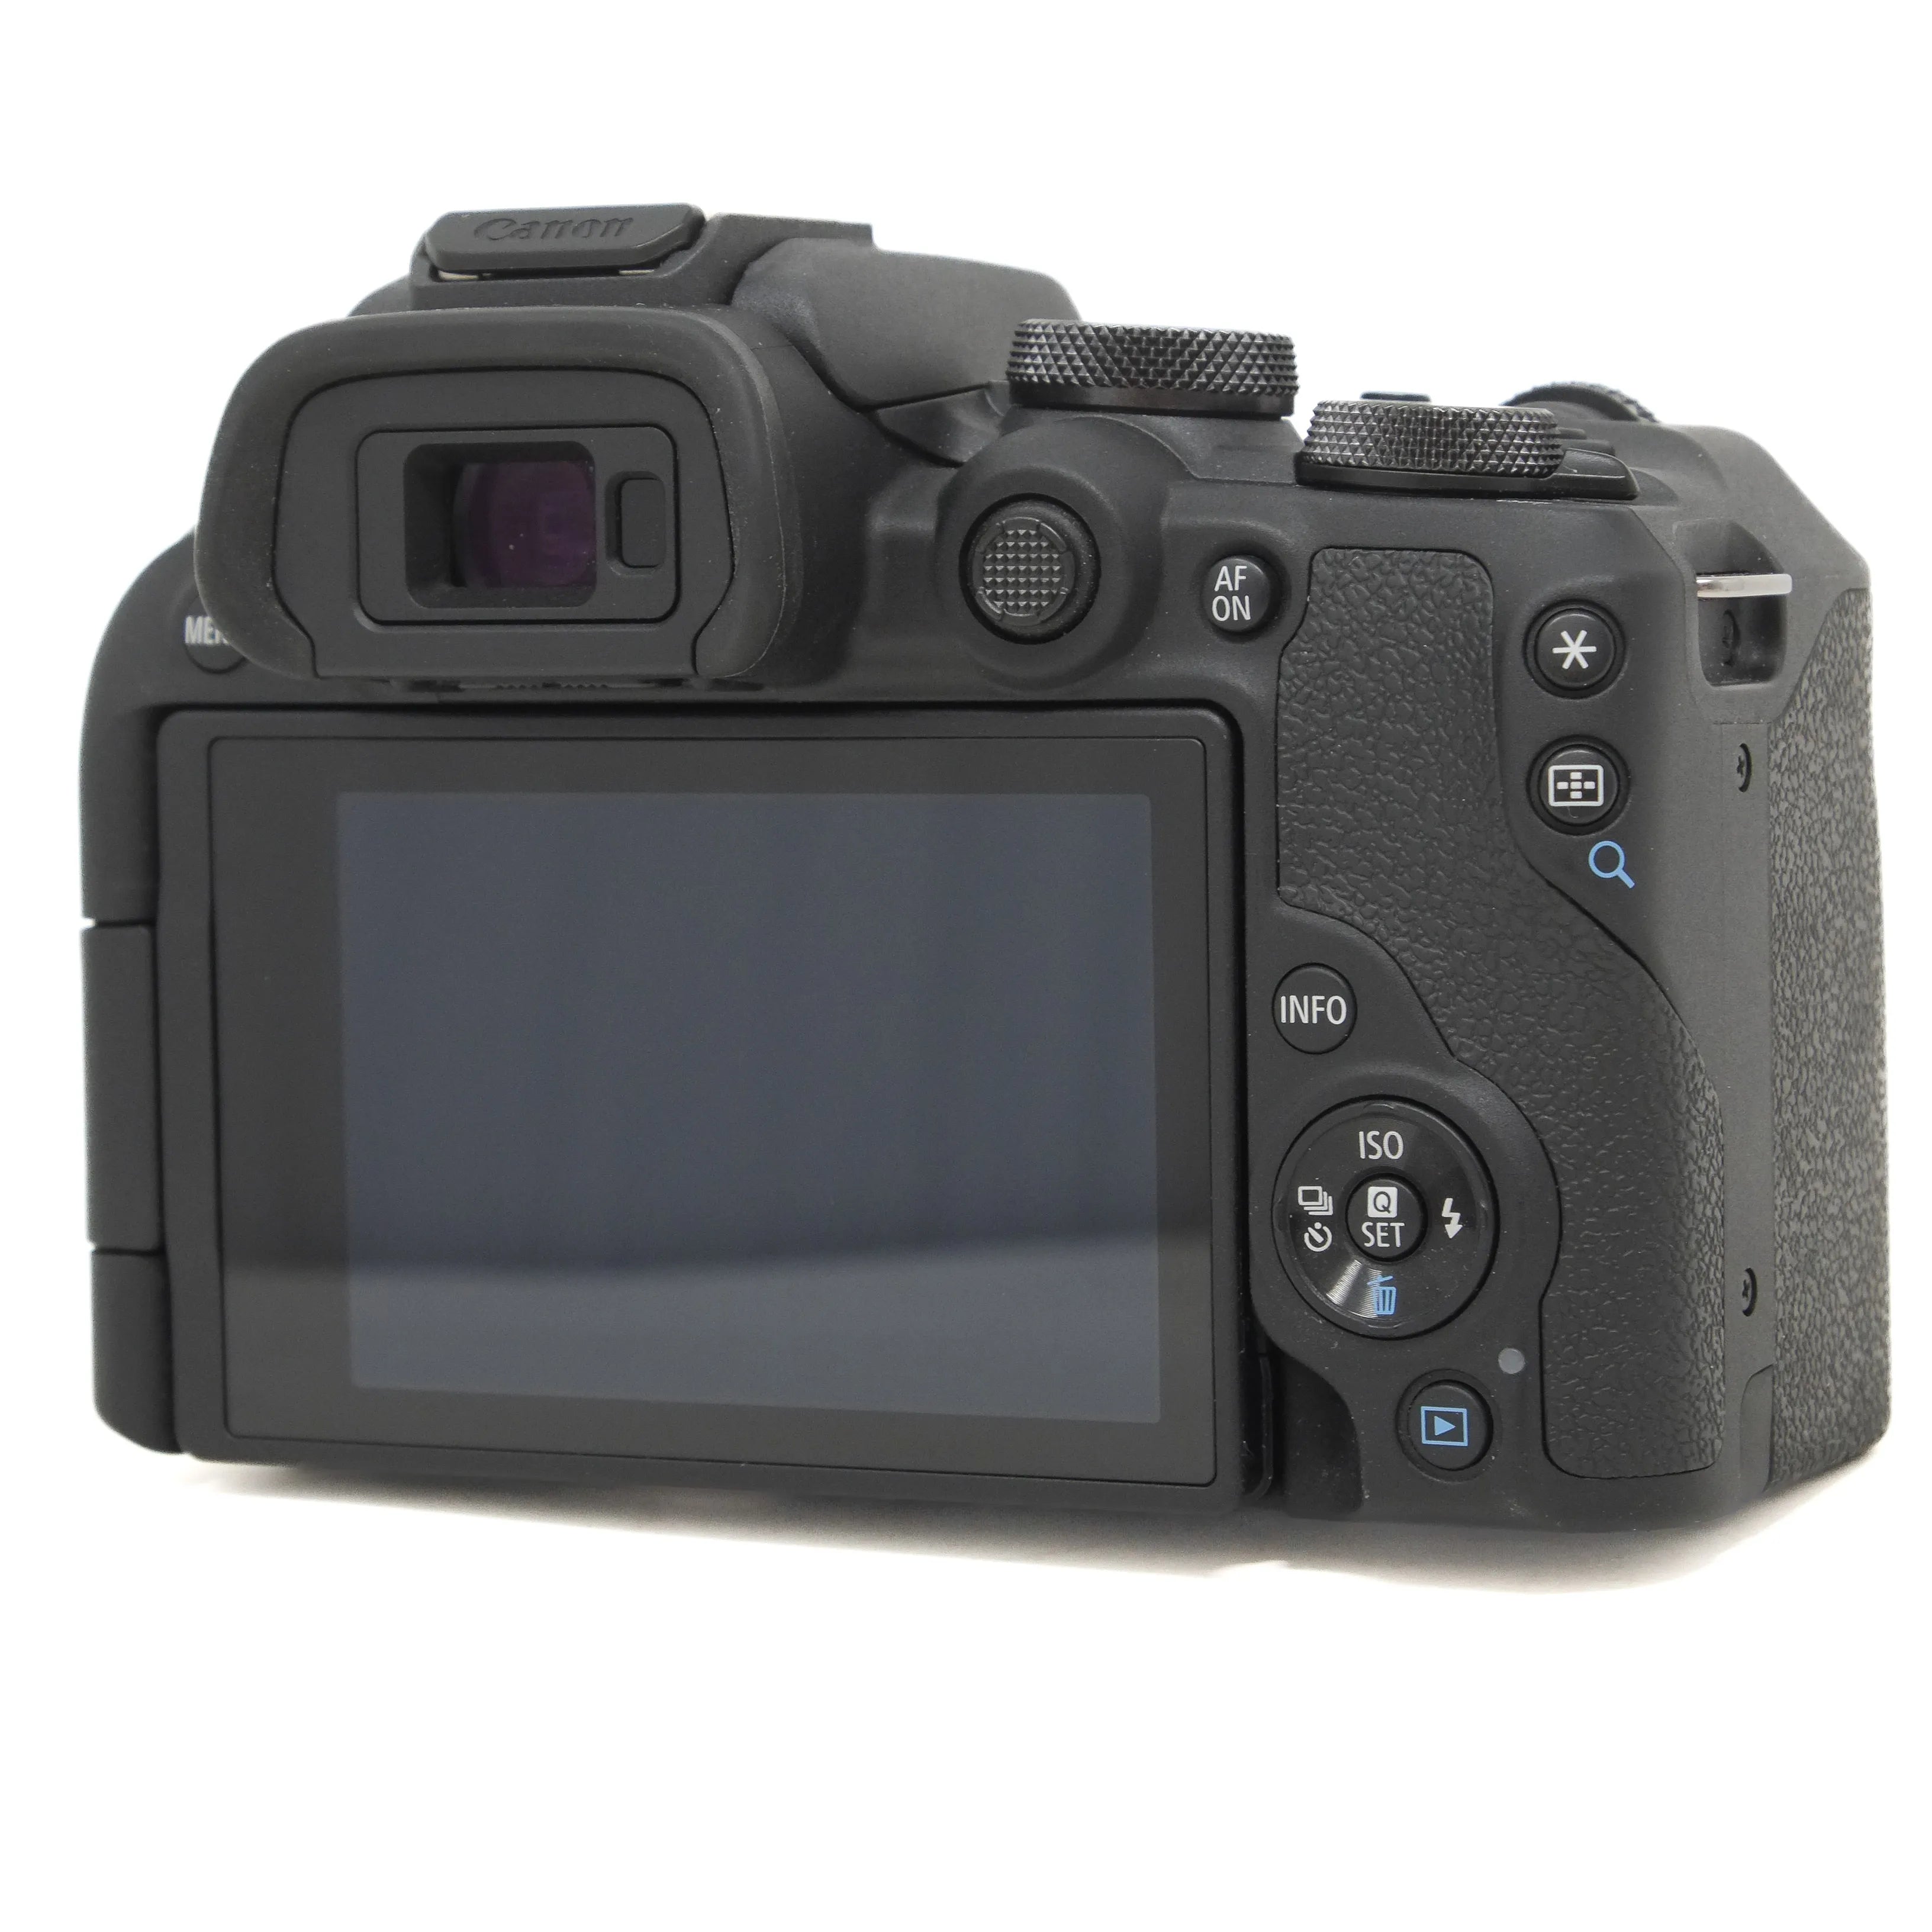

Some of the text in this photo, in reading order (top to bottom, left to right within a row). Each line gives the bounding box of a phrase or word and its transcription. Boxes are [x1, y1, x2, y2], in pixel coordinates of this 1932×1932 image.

[474, 218, 633, 240] Canon
[1214, 565, 1247, 592] AF
[1212, 595, 1251, 622] ON
[1280, 995, 1347, 1025] INFO
[1359, 1131, 1403, 1160] ISO
[1373, 1191, 1391, 1213] Q
[1361, 1222, 1405, 1247] SET
